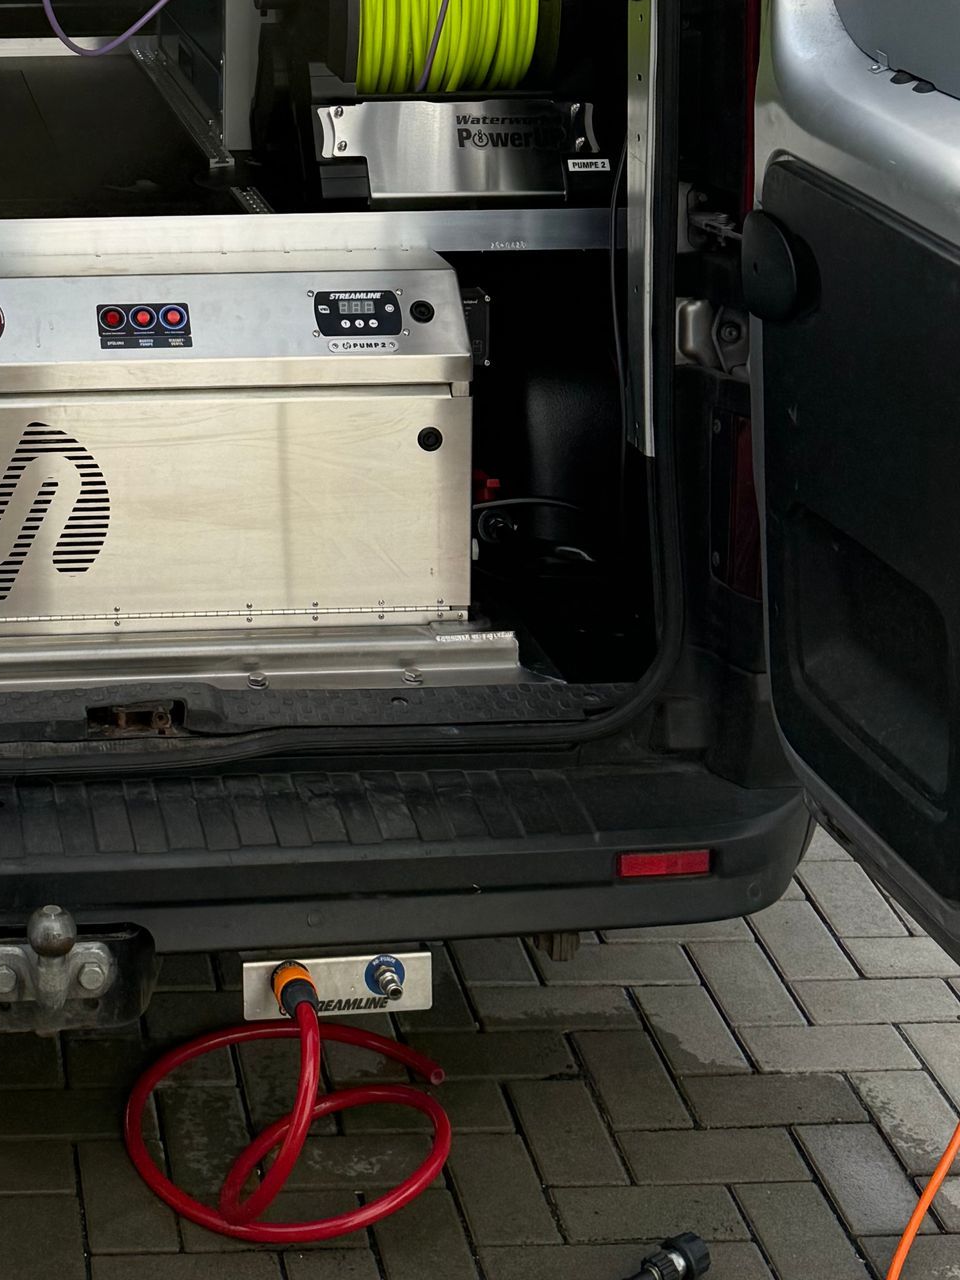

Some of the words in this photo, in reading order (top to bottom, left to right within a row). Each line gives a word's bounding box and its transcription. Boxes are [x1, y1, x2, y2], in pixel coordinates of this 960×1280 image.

[572, 161, 599, 169] PUMPE
[601, 161, 606, 169] 2
[329, 292, 381, 300] STREAMLINE
[316, 997, 389, 1012] REAMLINE
